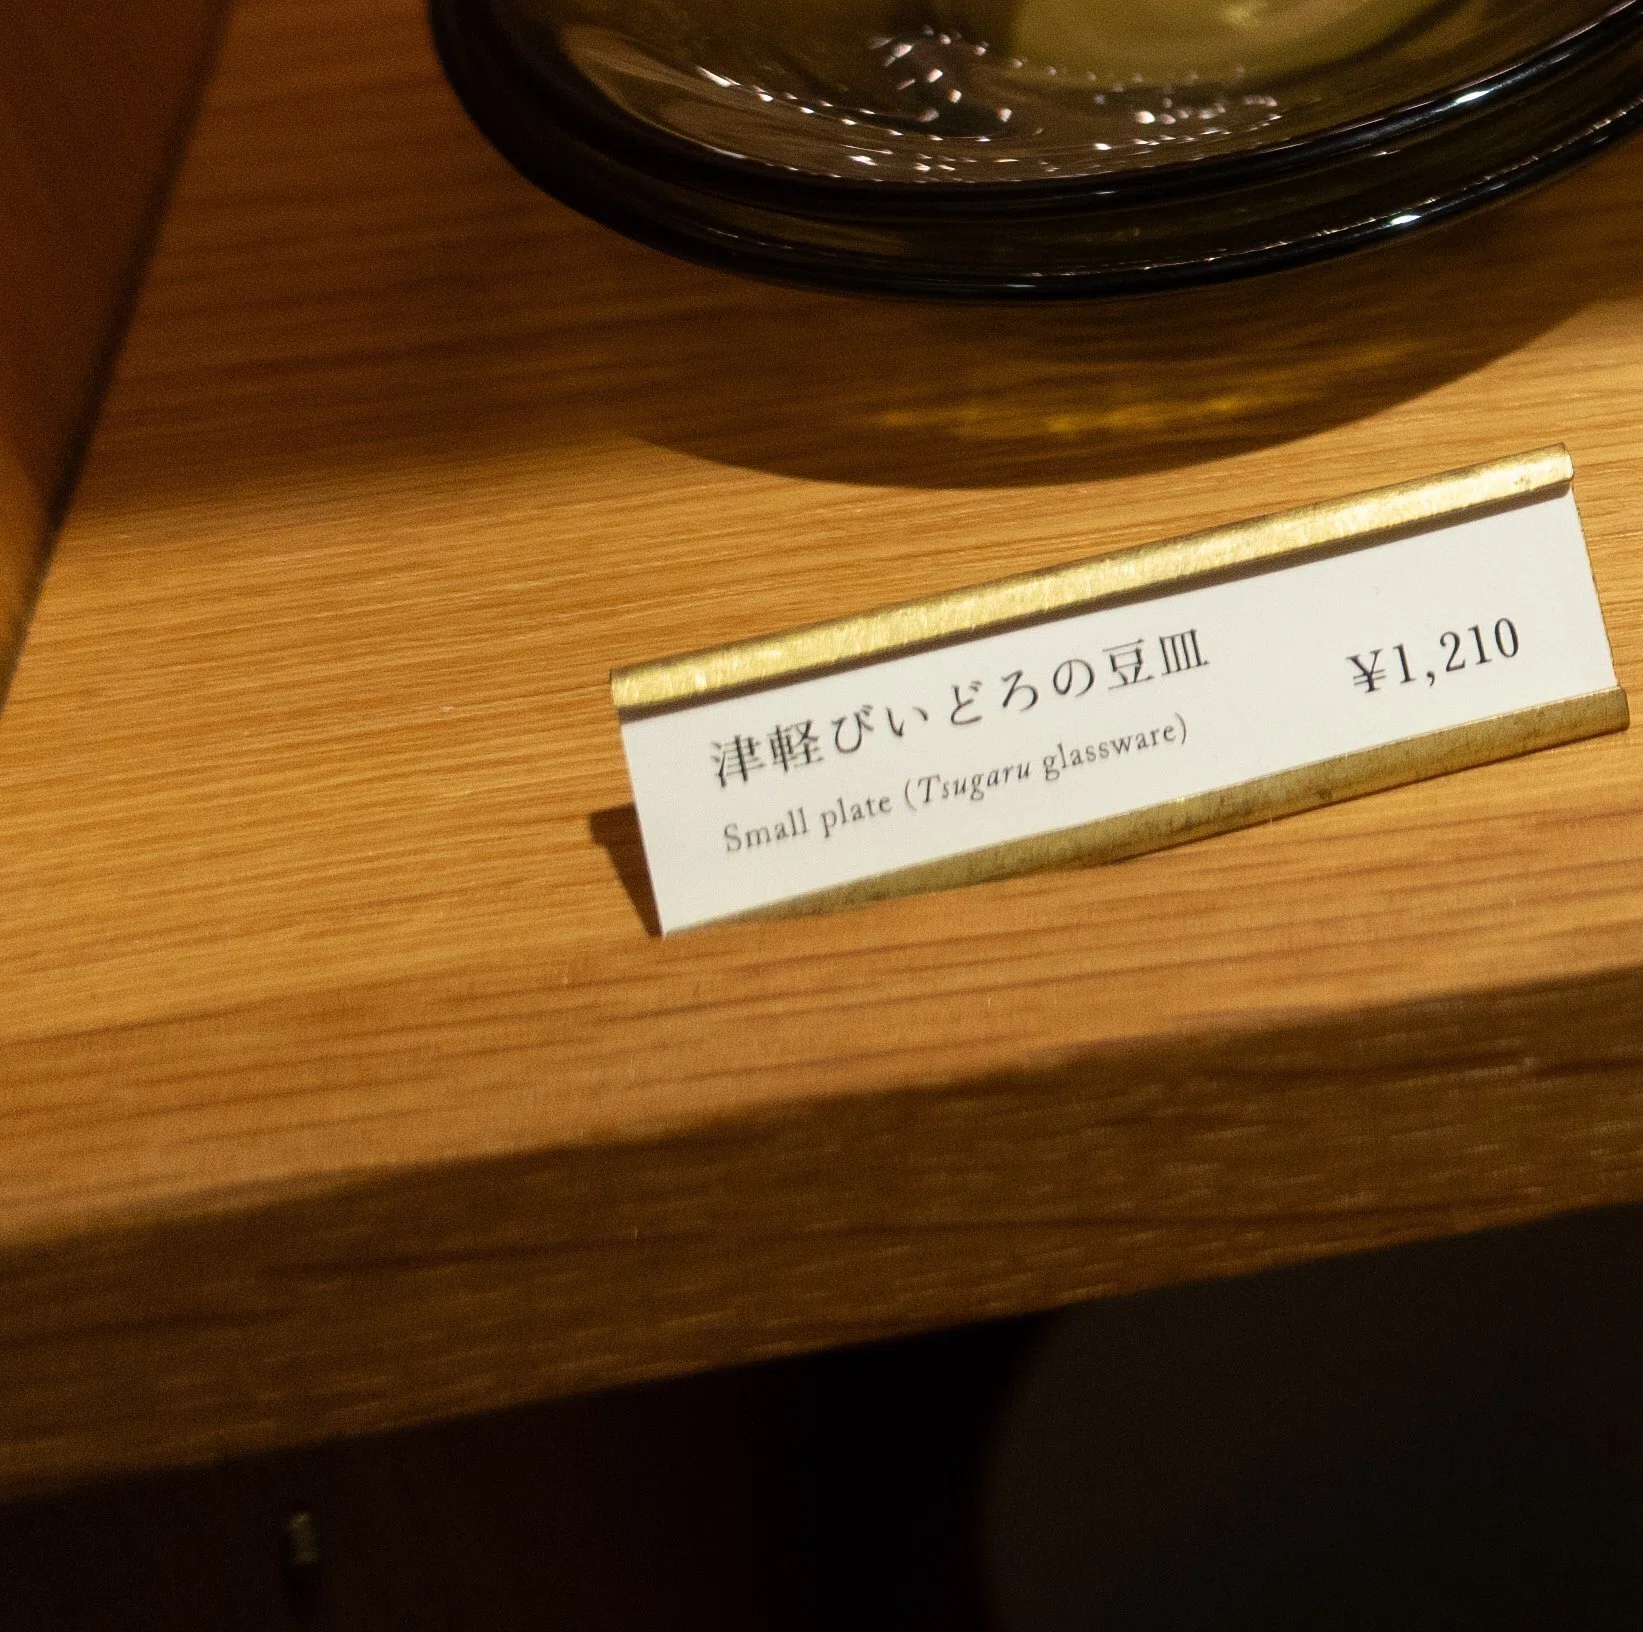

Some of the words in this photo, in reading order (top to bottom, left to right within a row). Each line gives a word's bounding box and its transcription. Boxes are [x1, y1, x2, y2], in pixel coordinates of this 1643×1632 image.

[709, 627, 1210, 788] 津軽びいどろの豆皿
[1345, 617, 1520, 694] ¥1,210
[723, 806, 809, 853] Small
[820, 792, 893, 840] plate
[904, 761, 1031, 812] (Tsugaru
[1042, 712, 1187, 783] glassware)
